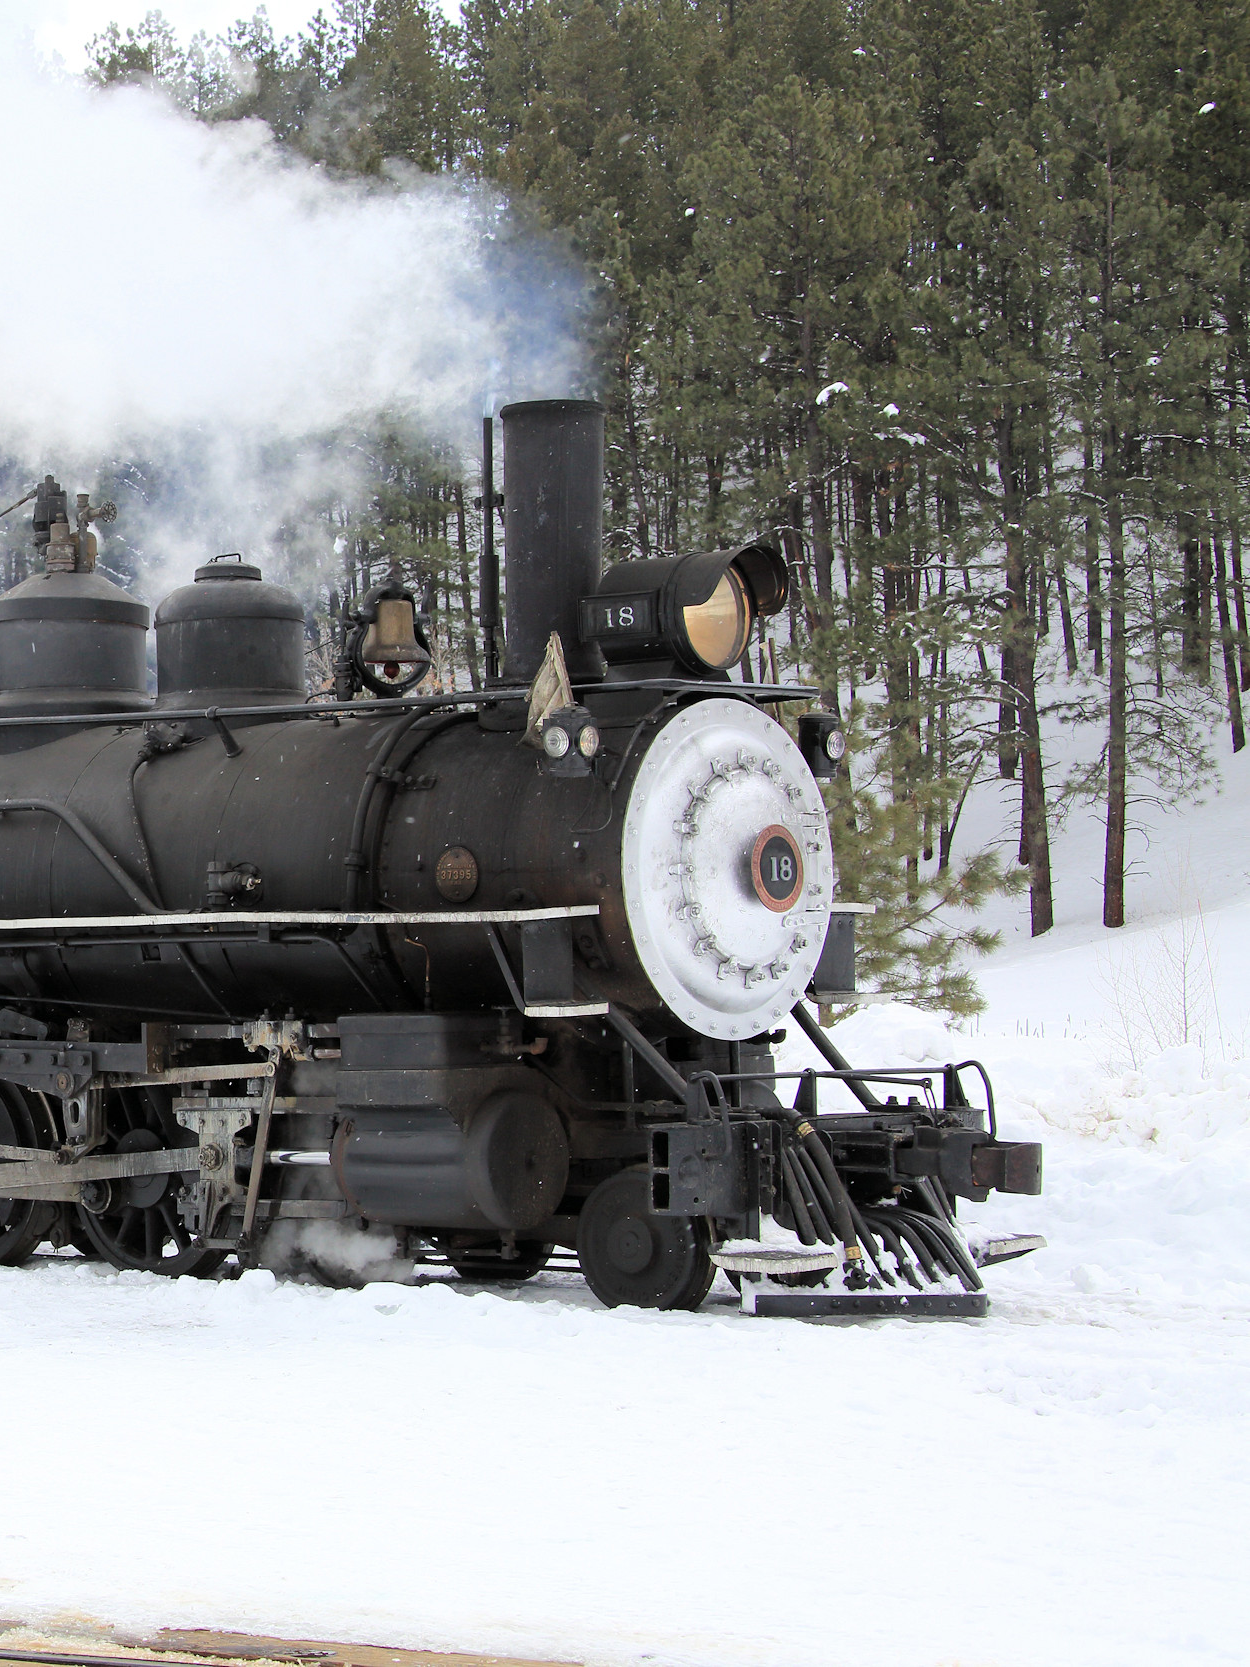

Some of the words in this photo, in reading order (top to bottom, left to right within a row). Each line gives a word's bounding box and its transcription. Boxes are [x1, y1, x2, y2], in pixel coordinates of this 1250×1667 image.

[604, 606, 635, 628] 18
[441, 870, 471, 880] 37395
[770, 855, 793, 882] 18
